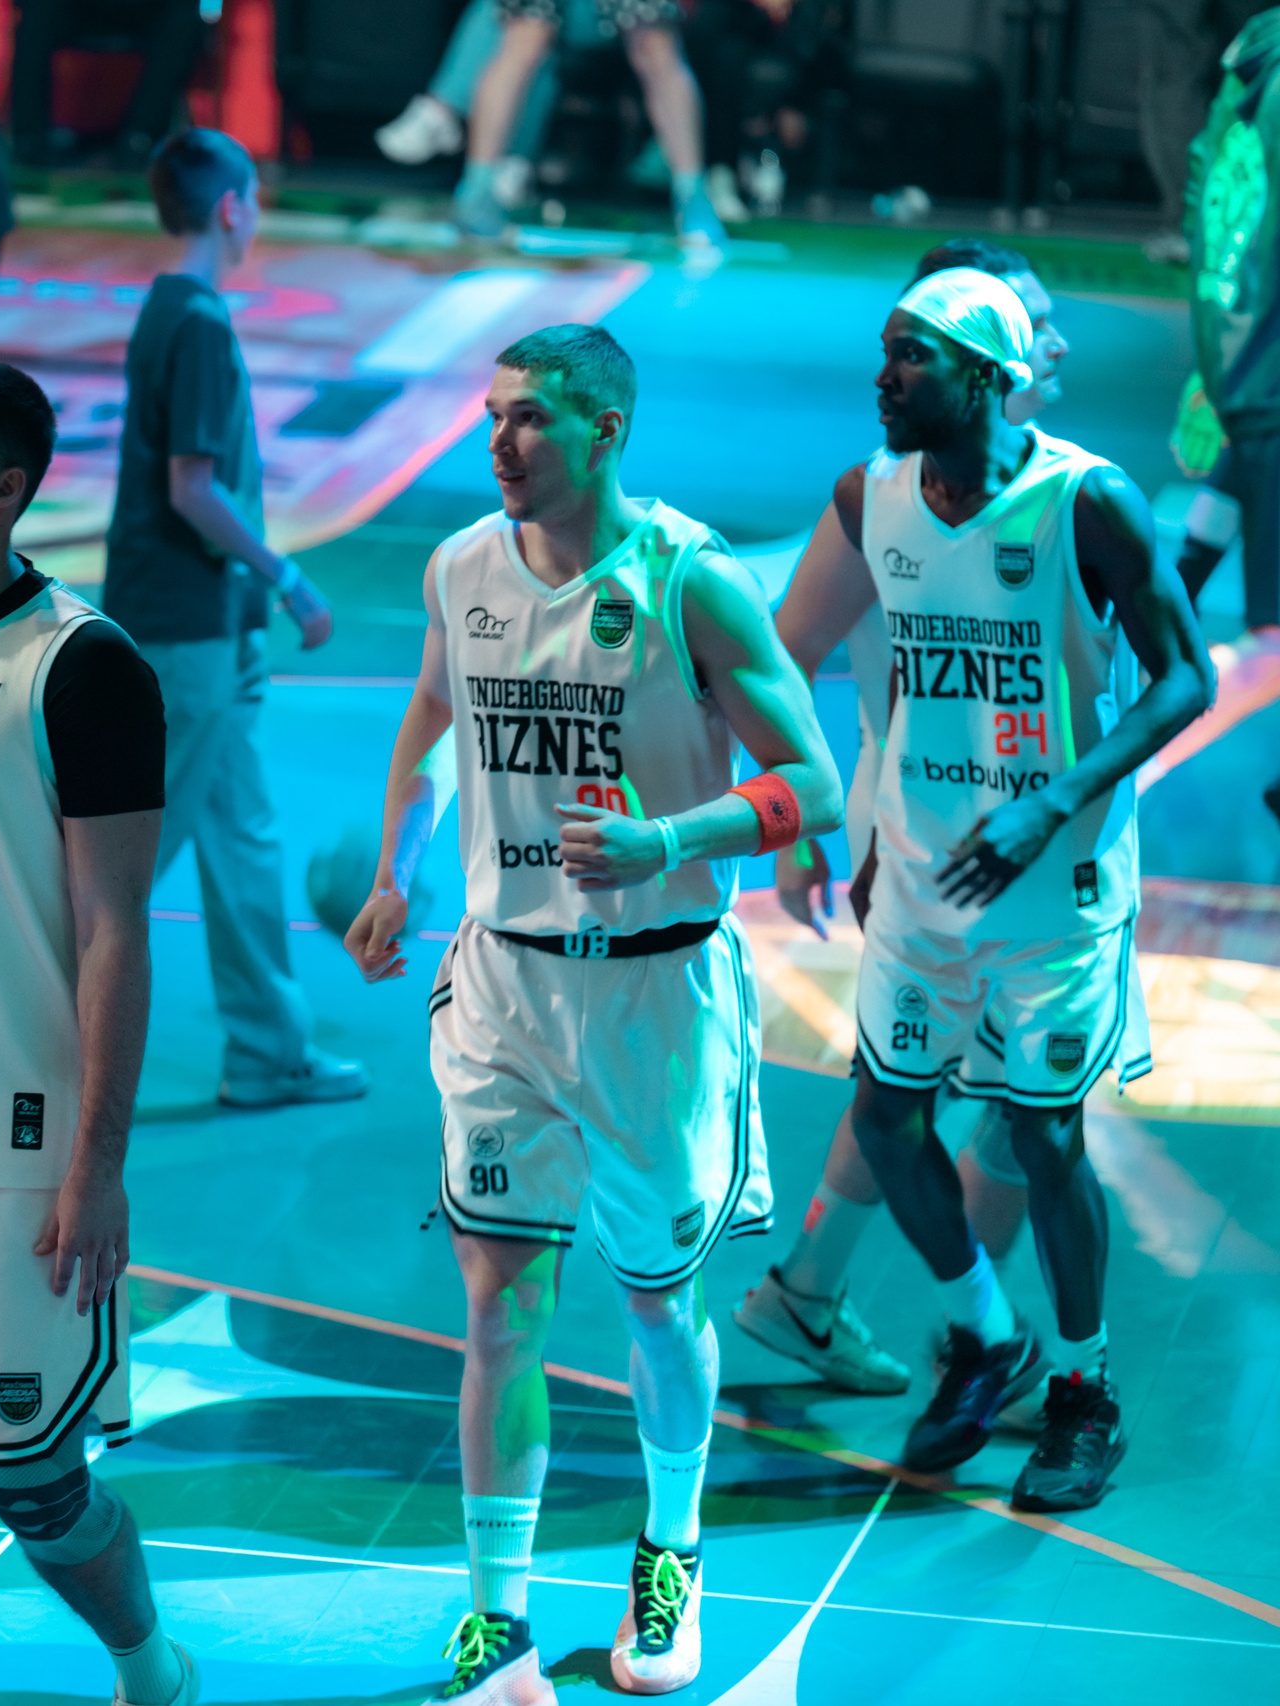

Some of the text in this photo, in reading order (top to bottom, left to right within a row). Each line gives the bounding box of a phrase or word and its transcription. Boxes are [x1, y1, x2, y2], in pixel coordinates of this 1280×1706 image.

[887, 610, 1041, 648] UNDERGROUND
[994, 711, 1048, 756] 24
[923, 757, 1050, 800] babulya
[892, 1021, 929, 1052] 24
[470, 1163, 509, 1197] 90
